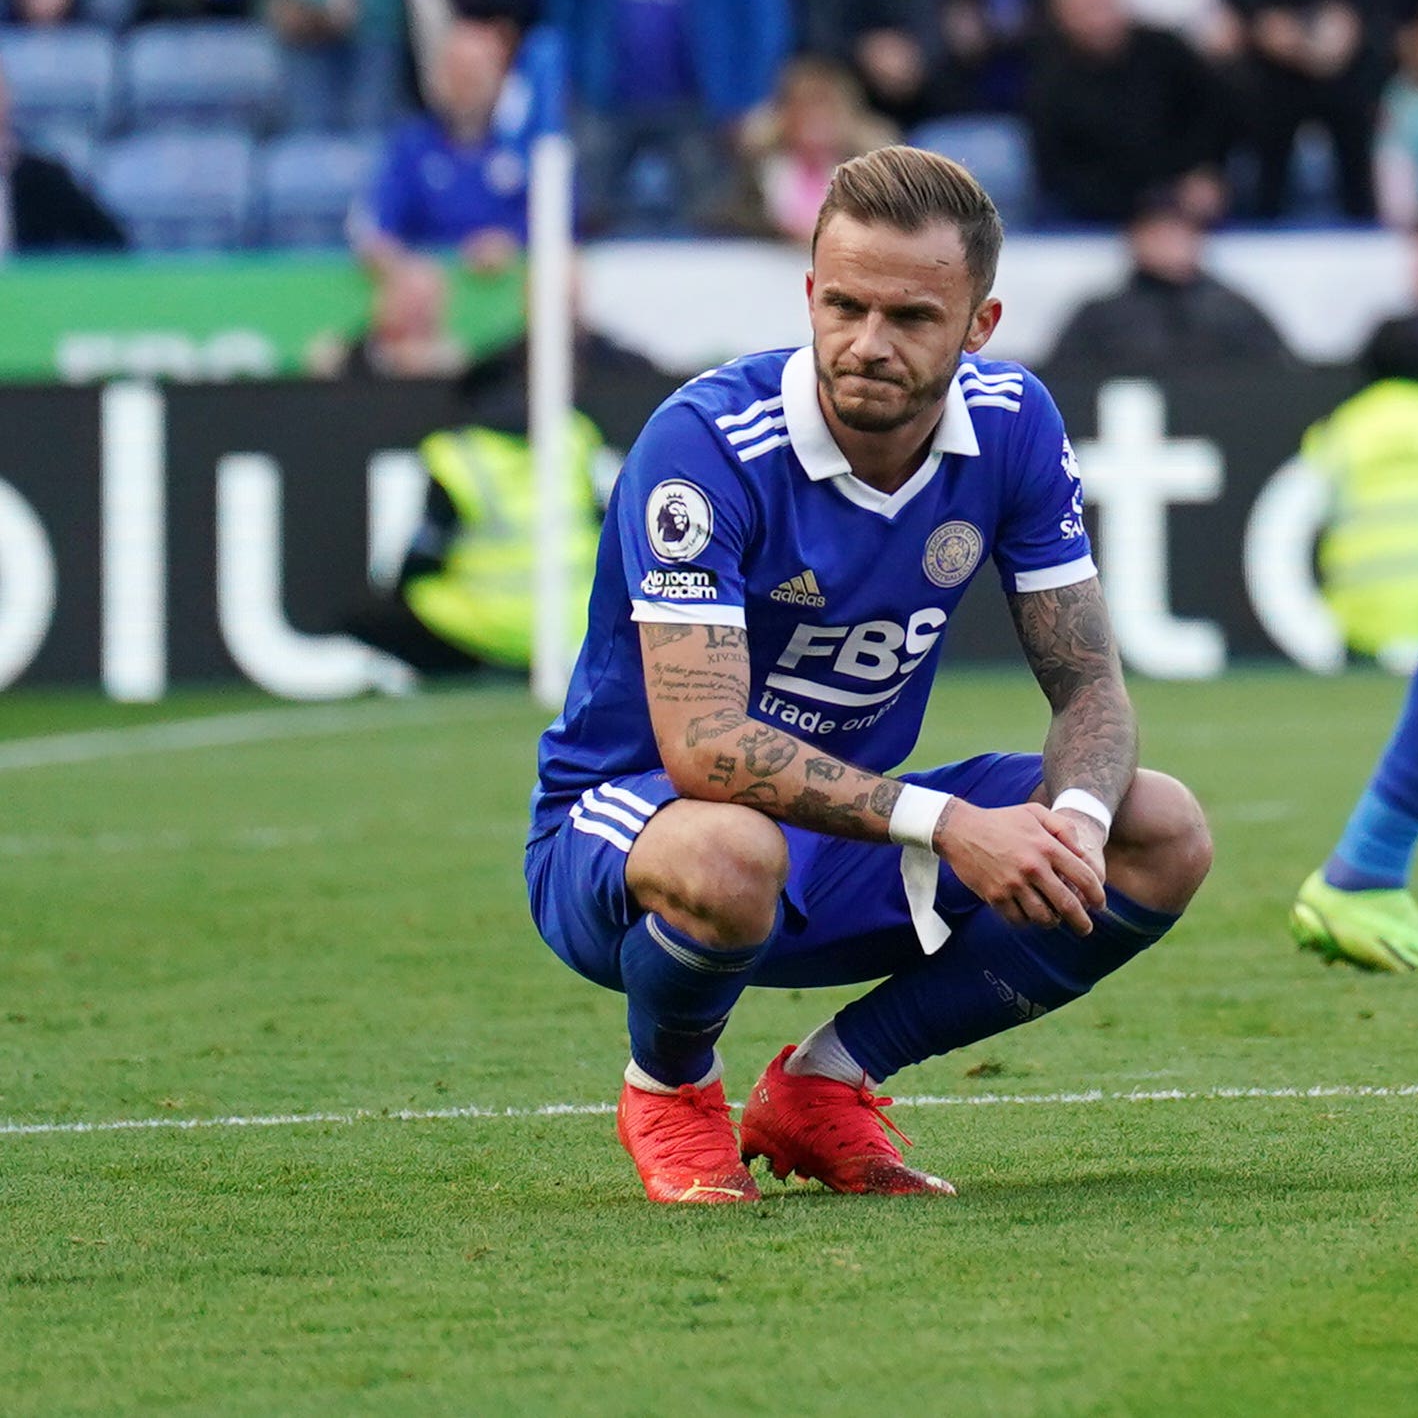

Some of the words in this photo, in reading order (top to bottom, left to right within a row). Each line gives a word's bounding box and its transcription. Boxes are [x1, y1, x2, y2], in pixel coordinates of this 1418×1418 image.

[665, 571, 709, 586] room
[661, 583, 718, 600] racism
[769, 587, 827, 609] adidas
[775, 606, 948, 682] FBS
[758, 689, 836, 735] trade
